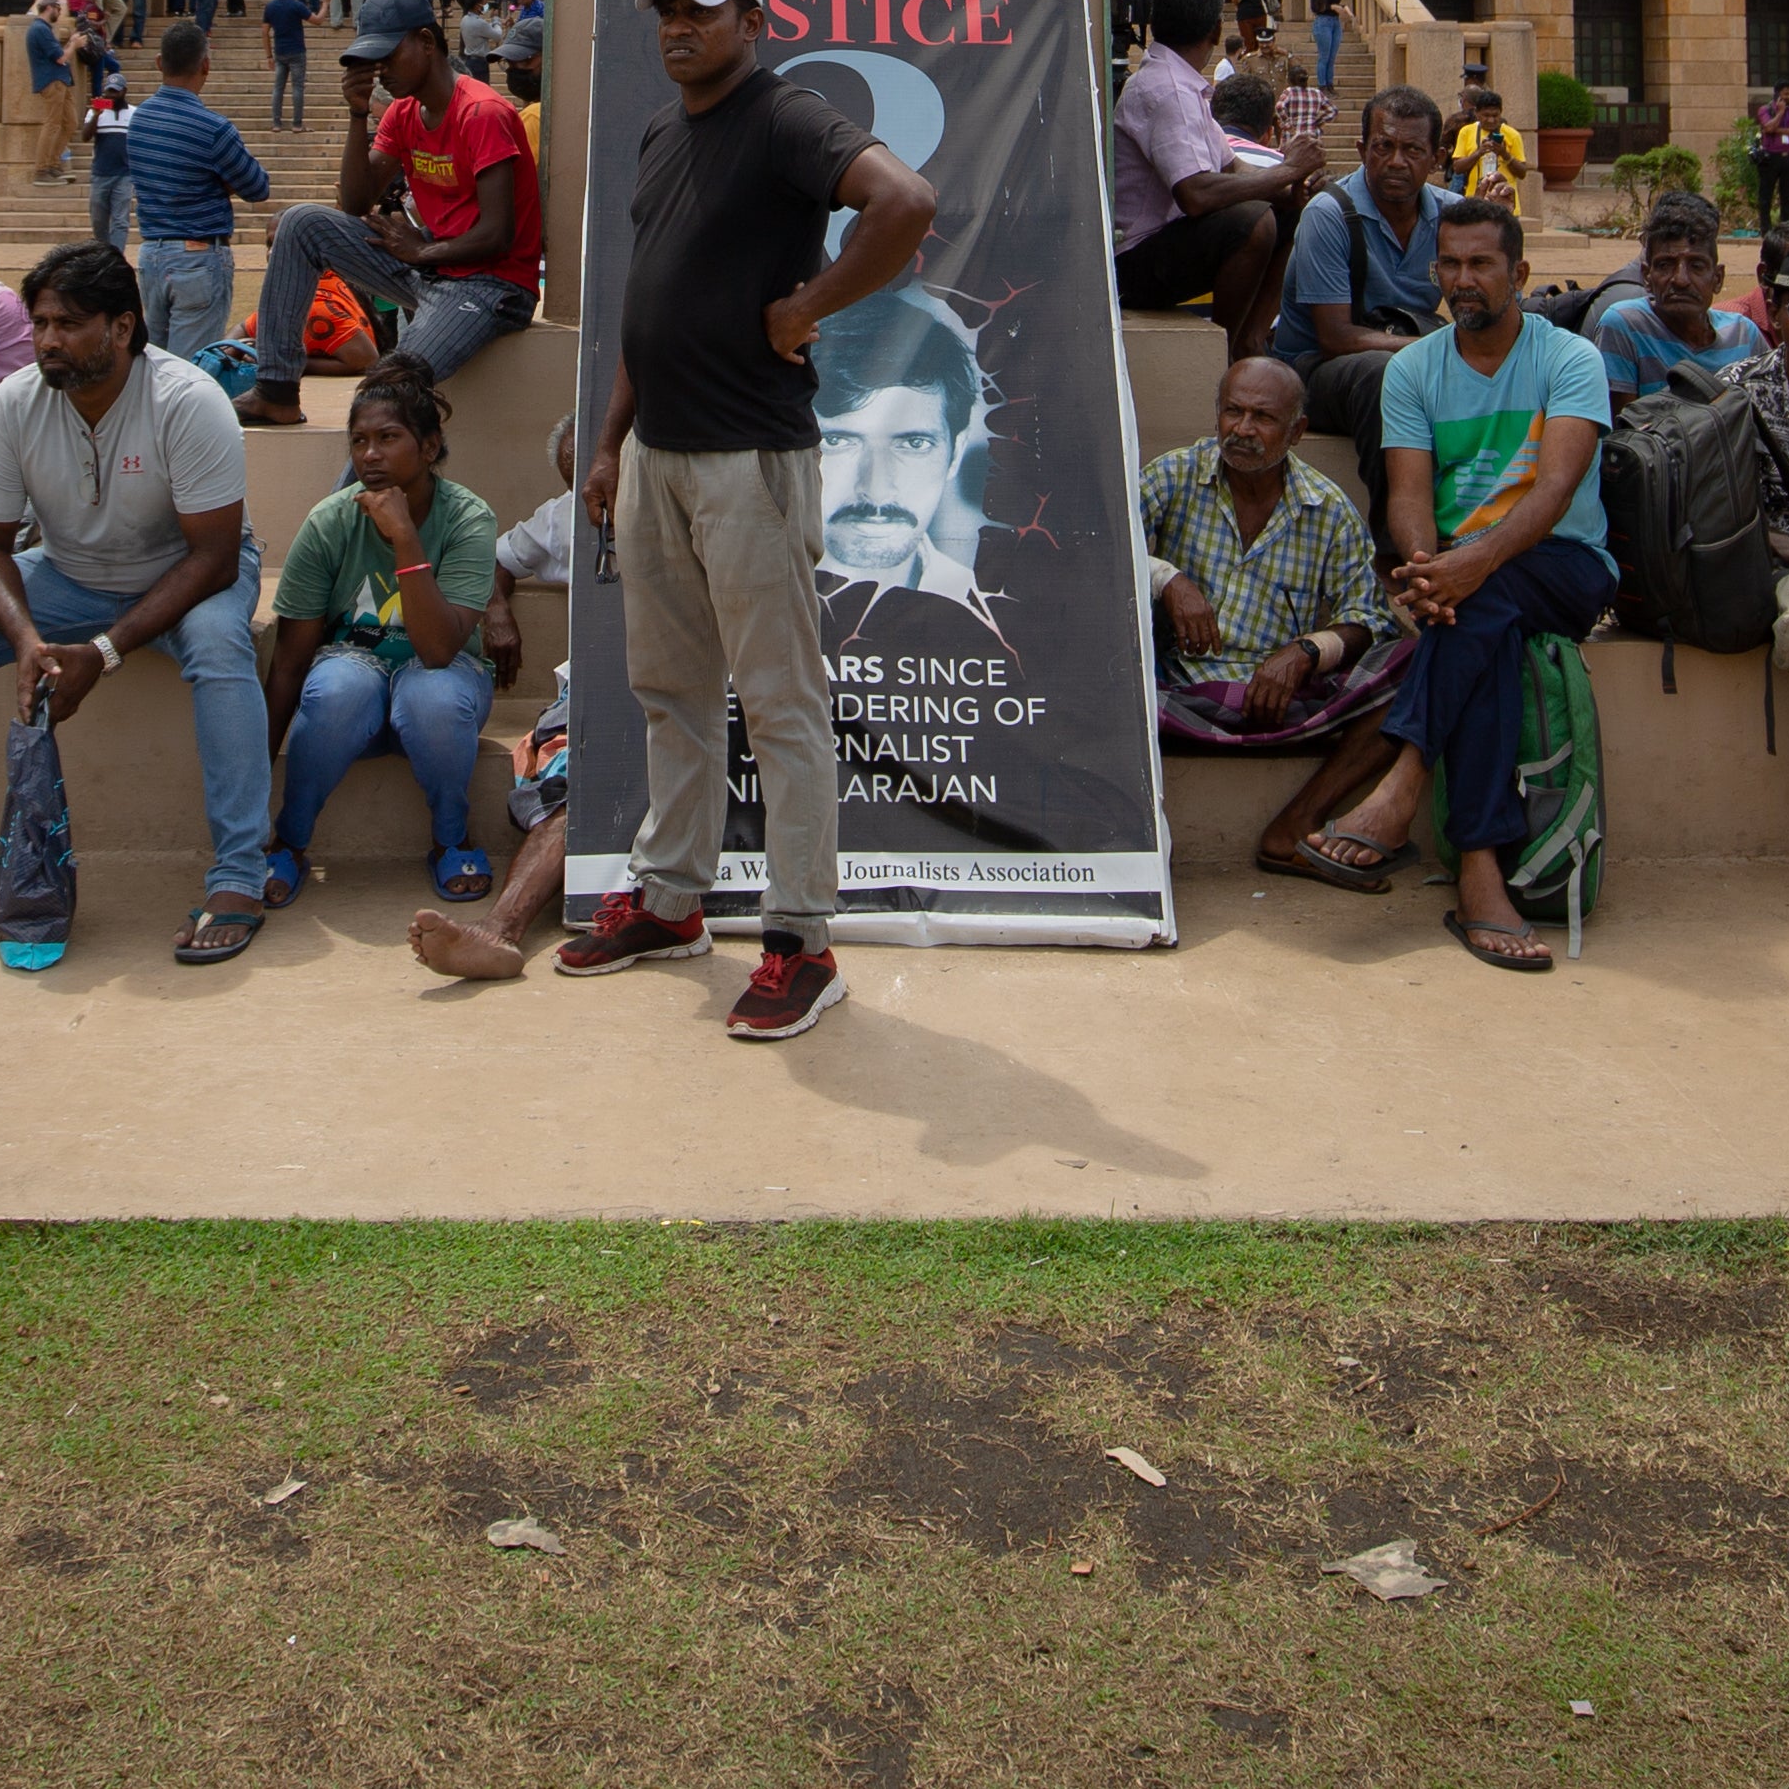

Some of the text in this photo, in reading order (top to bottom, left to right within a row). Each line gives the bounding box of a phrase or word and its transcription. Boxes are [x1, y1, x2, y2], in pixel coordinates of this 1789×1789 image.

[821, 655, 1007, 686] ARS SINCE
[830, 693, 1046, 726] DERING OF
[843, 860, 1096, 883] Journalists Association
